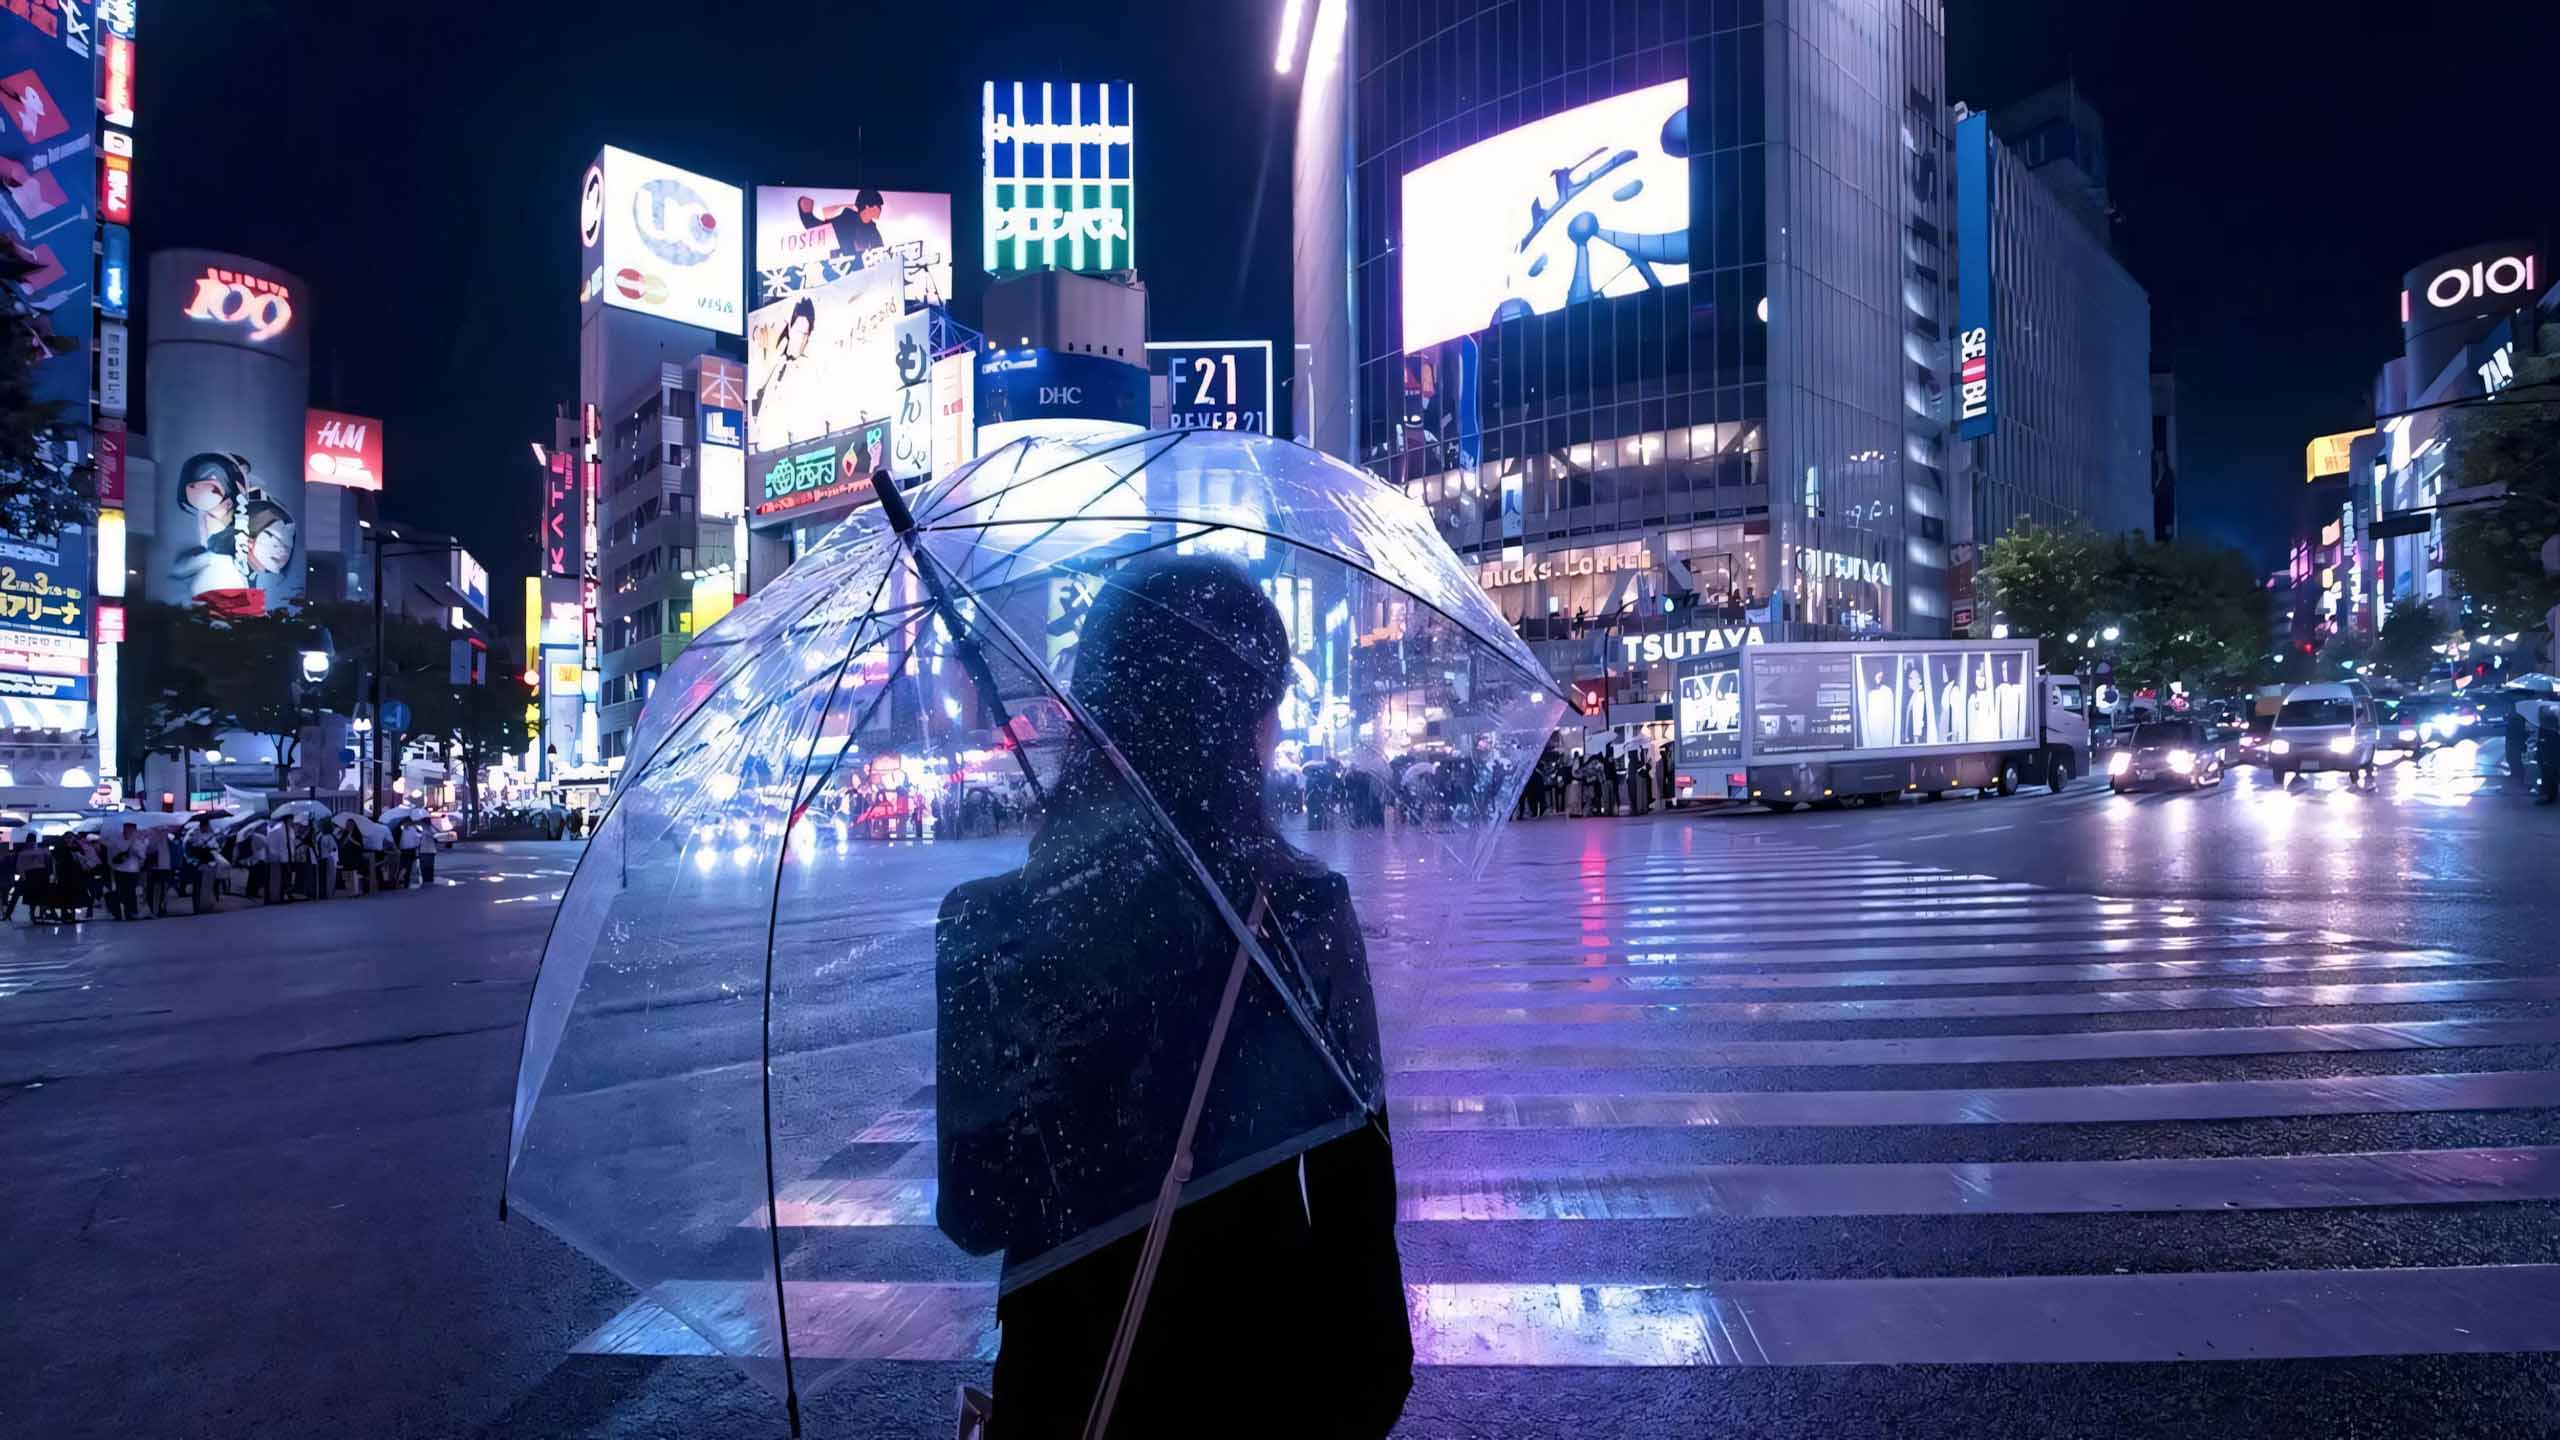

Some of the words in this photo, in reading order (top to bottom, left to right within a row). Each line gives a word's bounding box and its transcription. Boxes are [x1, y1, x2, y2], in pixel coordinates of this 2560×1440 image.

[183, 278, 292, 341] 109
[697, 296, 734, 313] VISA
[1961, 327, 1988, 420] SEIBU
[1039, 386, 1083, 405] DHC
[317, 420, 367, 454] H&M
[1622, 626, 1765, 664] TSUTAYA
